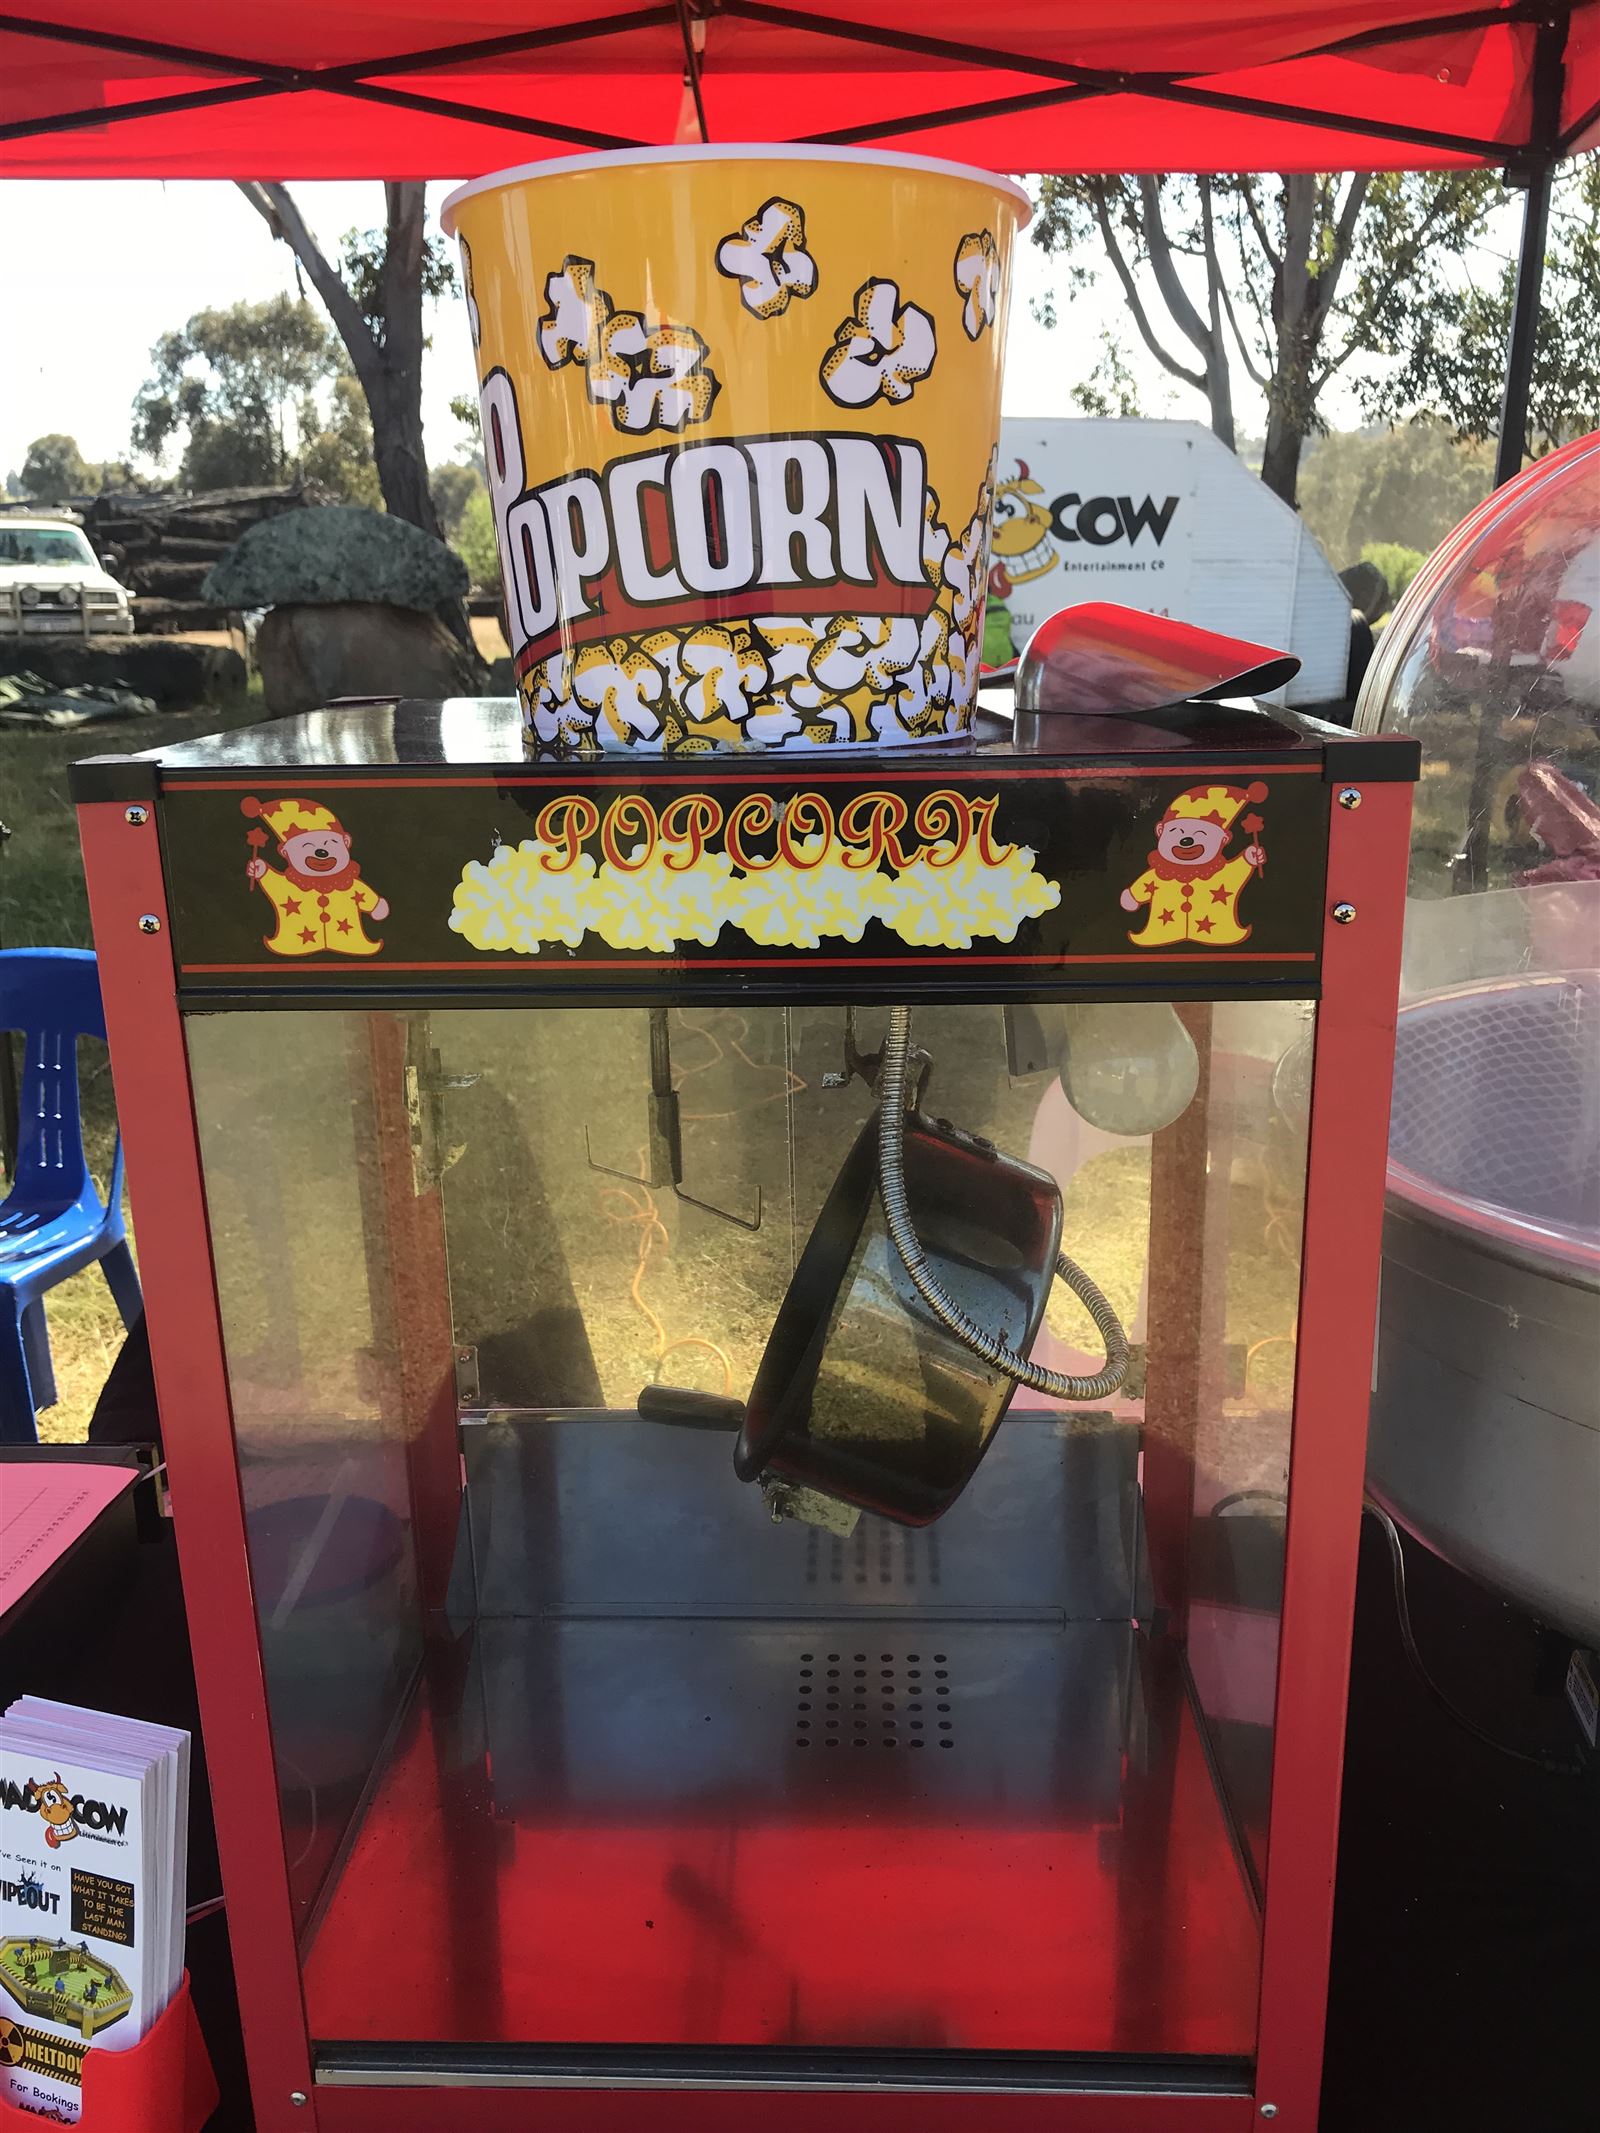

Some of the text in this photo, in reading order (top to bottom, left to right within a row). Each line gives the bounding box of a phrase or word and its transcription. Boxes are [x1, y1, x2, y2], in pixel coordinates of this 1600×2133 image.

[1049, 493, 1180, 547] COW
[1064, 561, 1146, 571] Entertainment
[536, 789, 1018, 873] POPCORN
[70, 1794, 128, 1837] COW
[16, 1855, 37, 1866] Seen
[40, 1860, 48, 1869] it
[51, 1864, 62, 1872] on
[74, 1872, 132, 1895] HAVE YOU GOT
[0, 1880, 60, 1915] IPEOUT
[72, 1884, 134, 1907] WHAT IT TAKES
[82, 1898, 124, 1917] TO BE THE
[81, 1922, 128, 1941] STANDING?
[84, 1911, 125, 1929] LAST MAN
[10, 2078, 79, 2111] For Bookings
